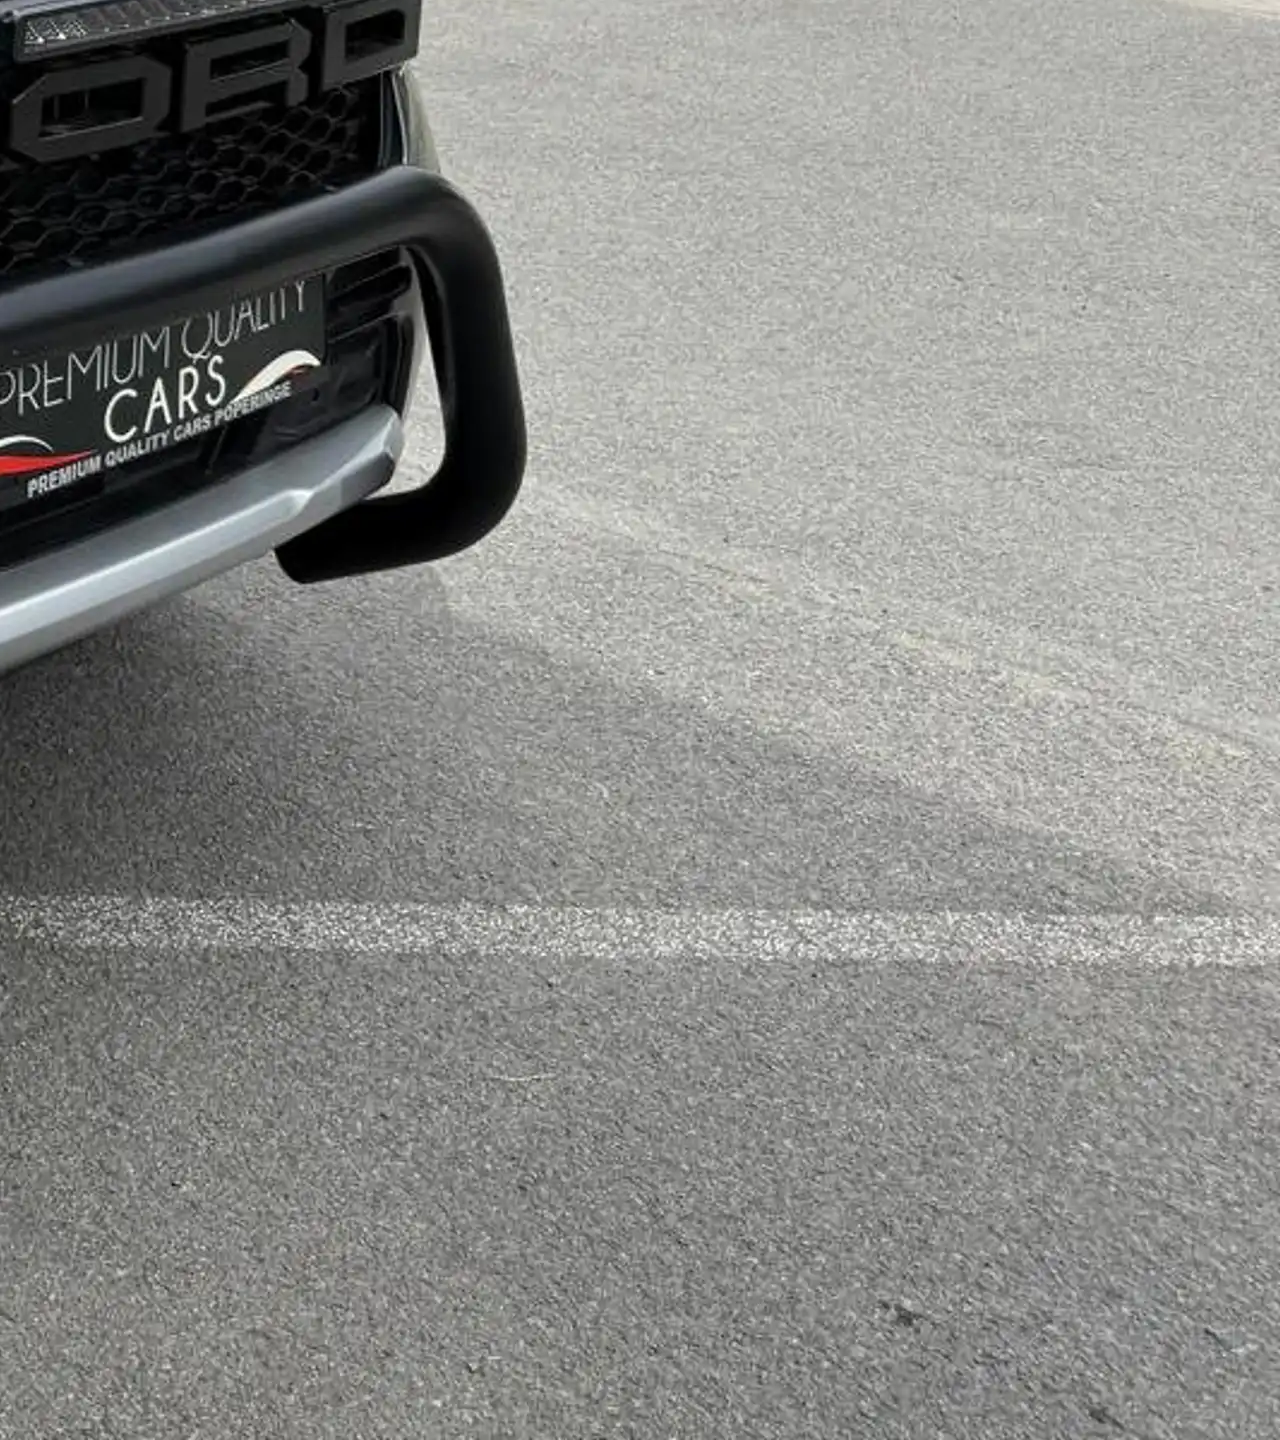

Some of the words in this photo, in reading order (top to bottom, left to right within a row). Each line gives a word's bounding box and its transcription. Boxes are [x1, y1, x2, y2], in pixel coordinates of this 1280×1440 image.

[180, 279, 307, 363] QUALITY
[27, 454, 101, 498] PREMIUM
[105, 429, 171, 468] QUALITY
[173, 413, 212, 440] CARS
[214, 380, 292, 426] POPERINGE
[104, 355, 227, 443] CARS
